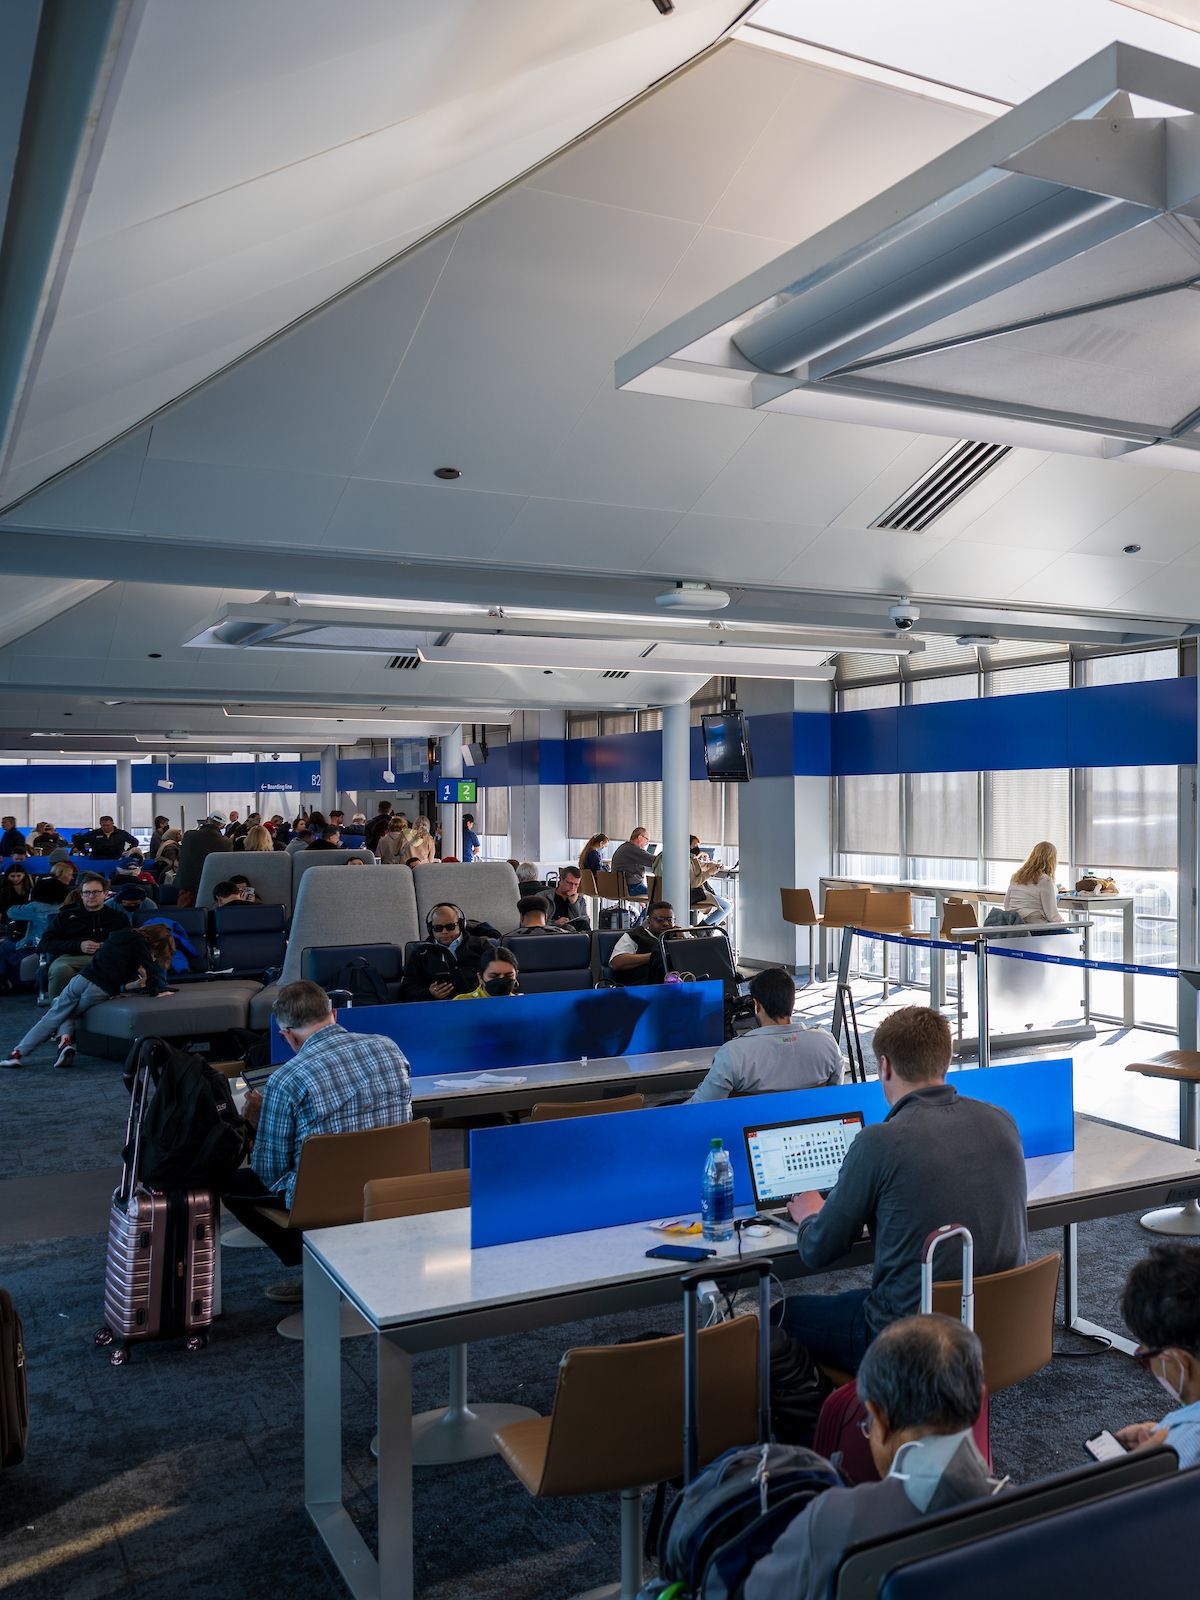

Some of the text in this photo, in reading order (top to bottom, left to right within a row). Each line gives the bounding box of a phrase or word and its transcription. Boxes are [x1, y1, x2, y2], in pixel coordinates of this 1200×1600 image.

[311, 774, 320, 786] B2
[267, 783, 285, 791] Boarding
[444, 785, 451, 795] 1
[463, 785, 470, 795] 2
